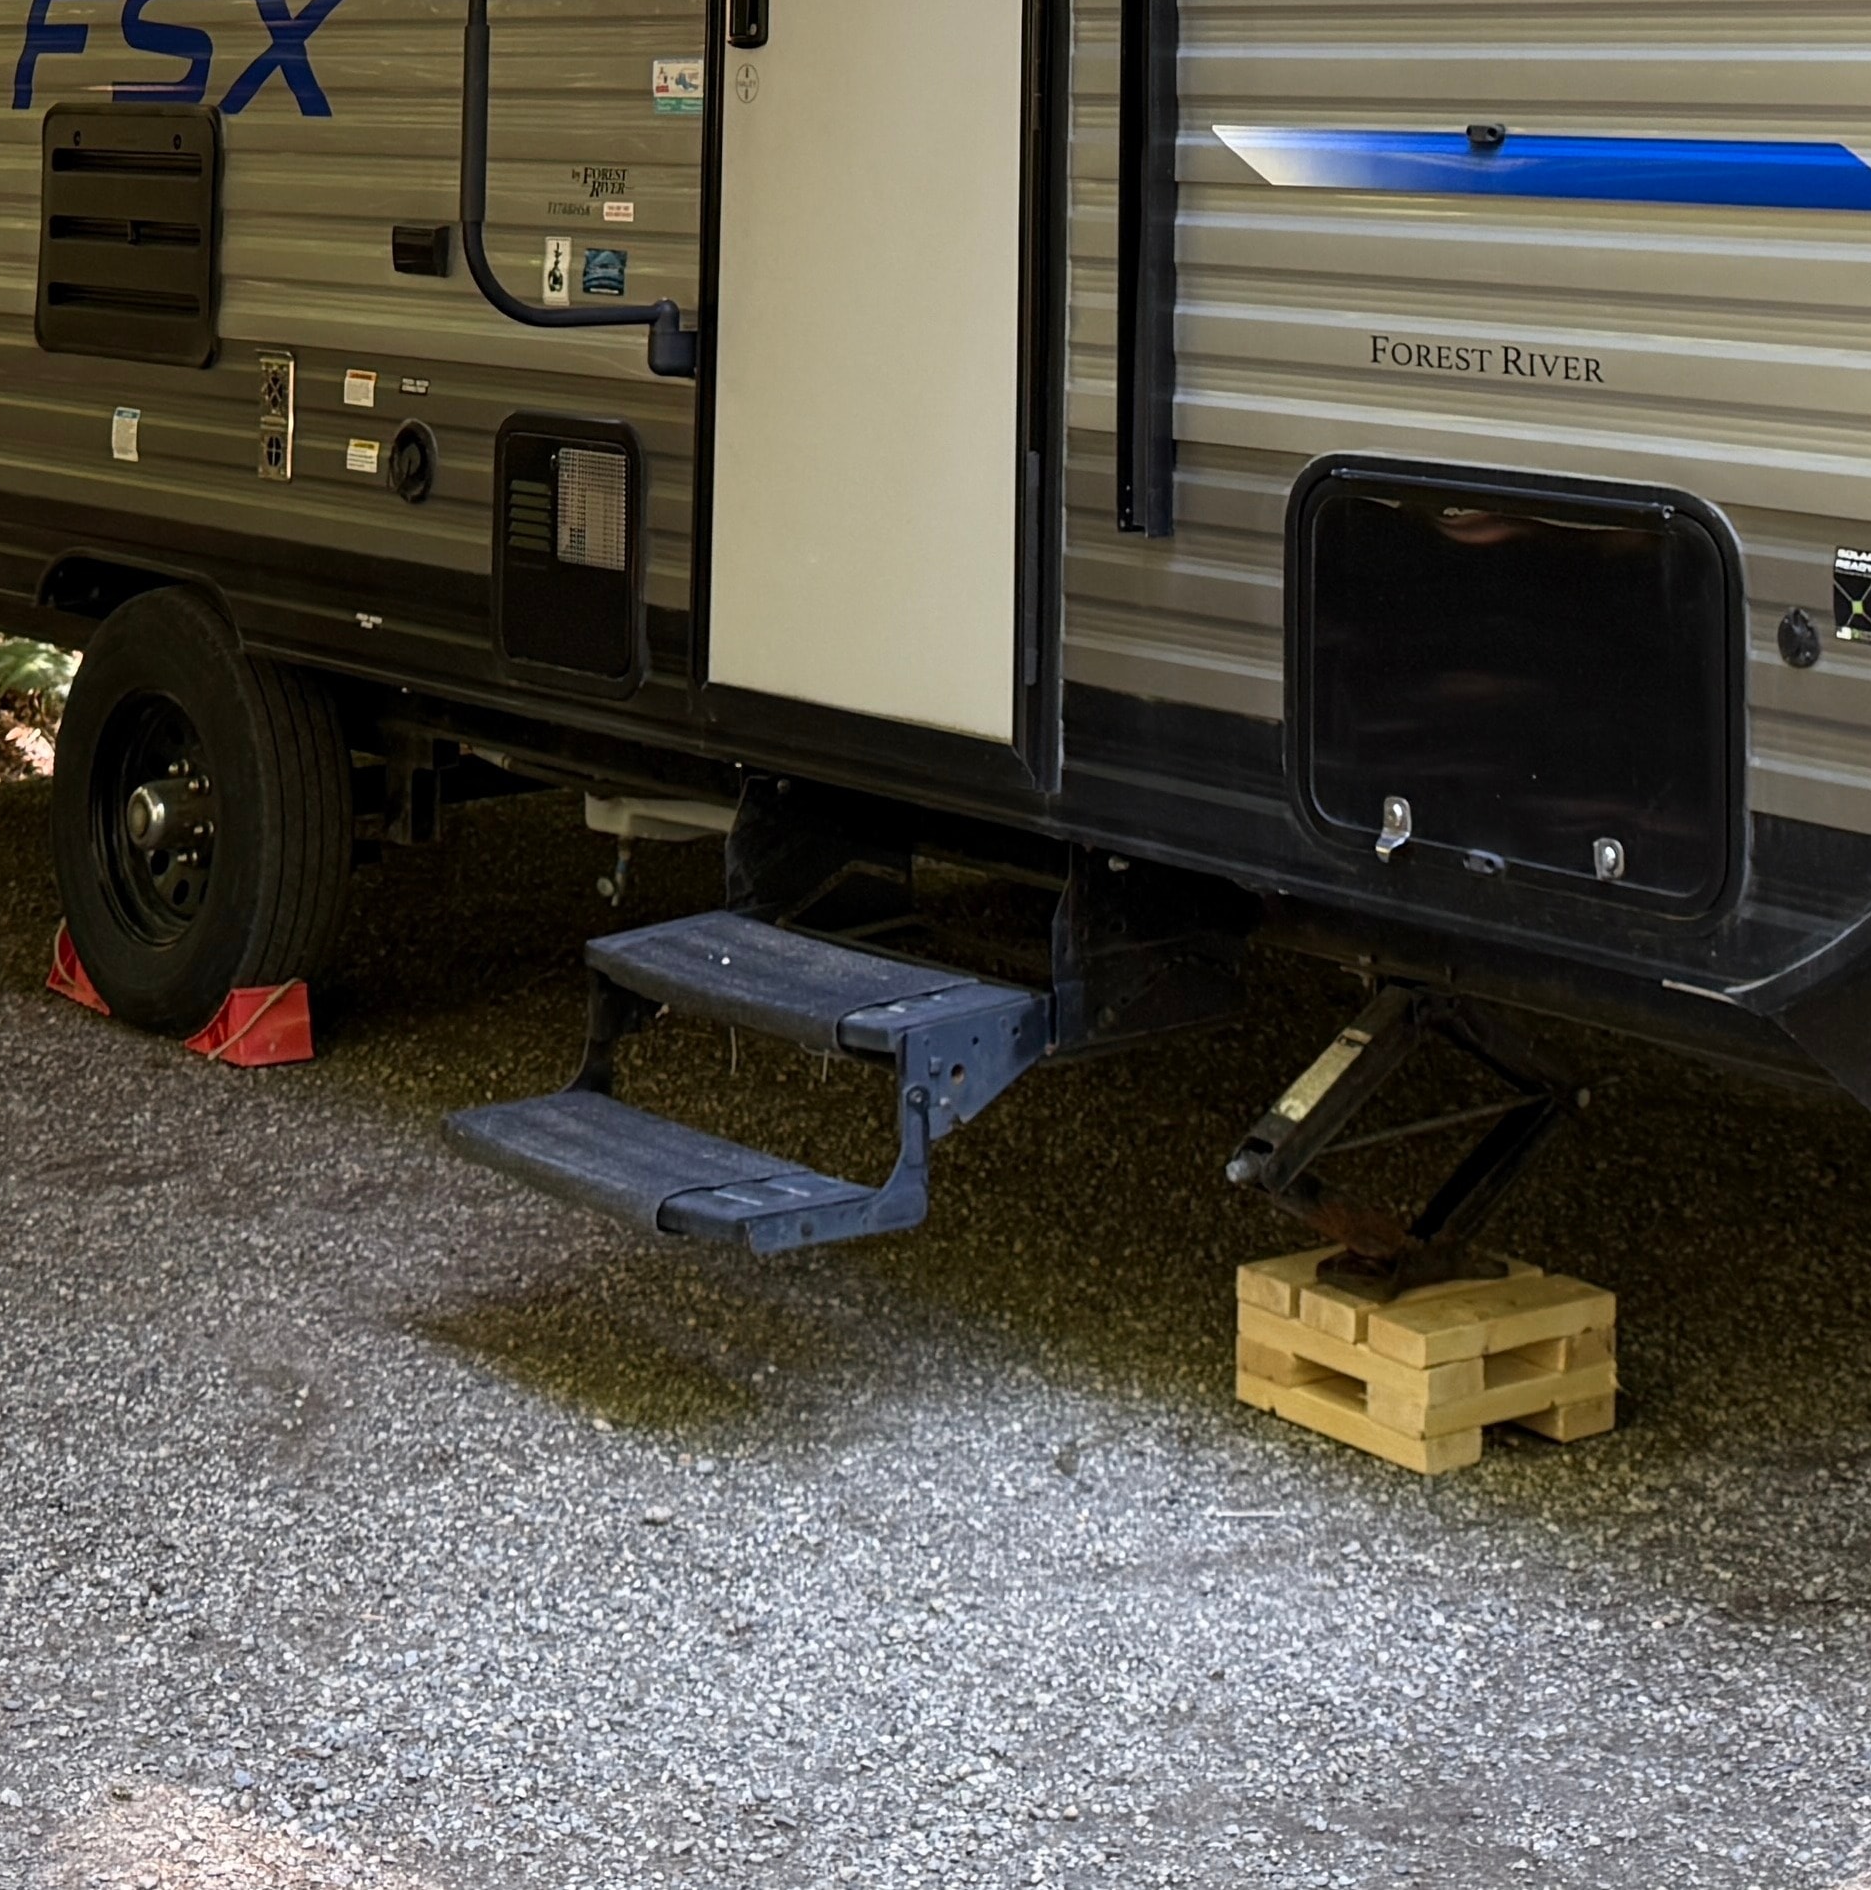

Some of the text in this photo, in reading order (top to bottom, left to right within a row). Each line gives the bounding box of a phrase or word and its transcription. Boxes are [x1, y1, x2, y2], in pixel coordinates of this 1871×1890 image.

[583, 167, 628, 184] FOREST
[589, 179, 627, 198] RIVER
[1369, 334, 1606, 384] FOREST RIVER
